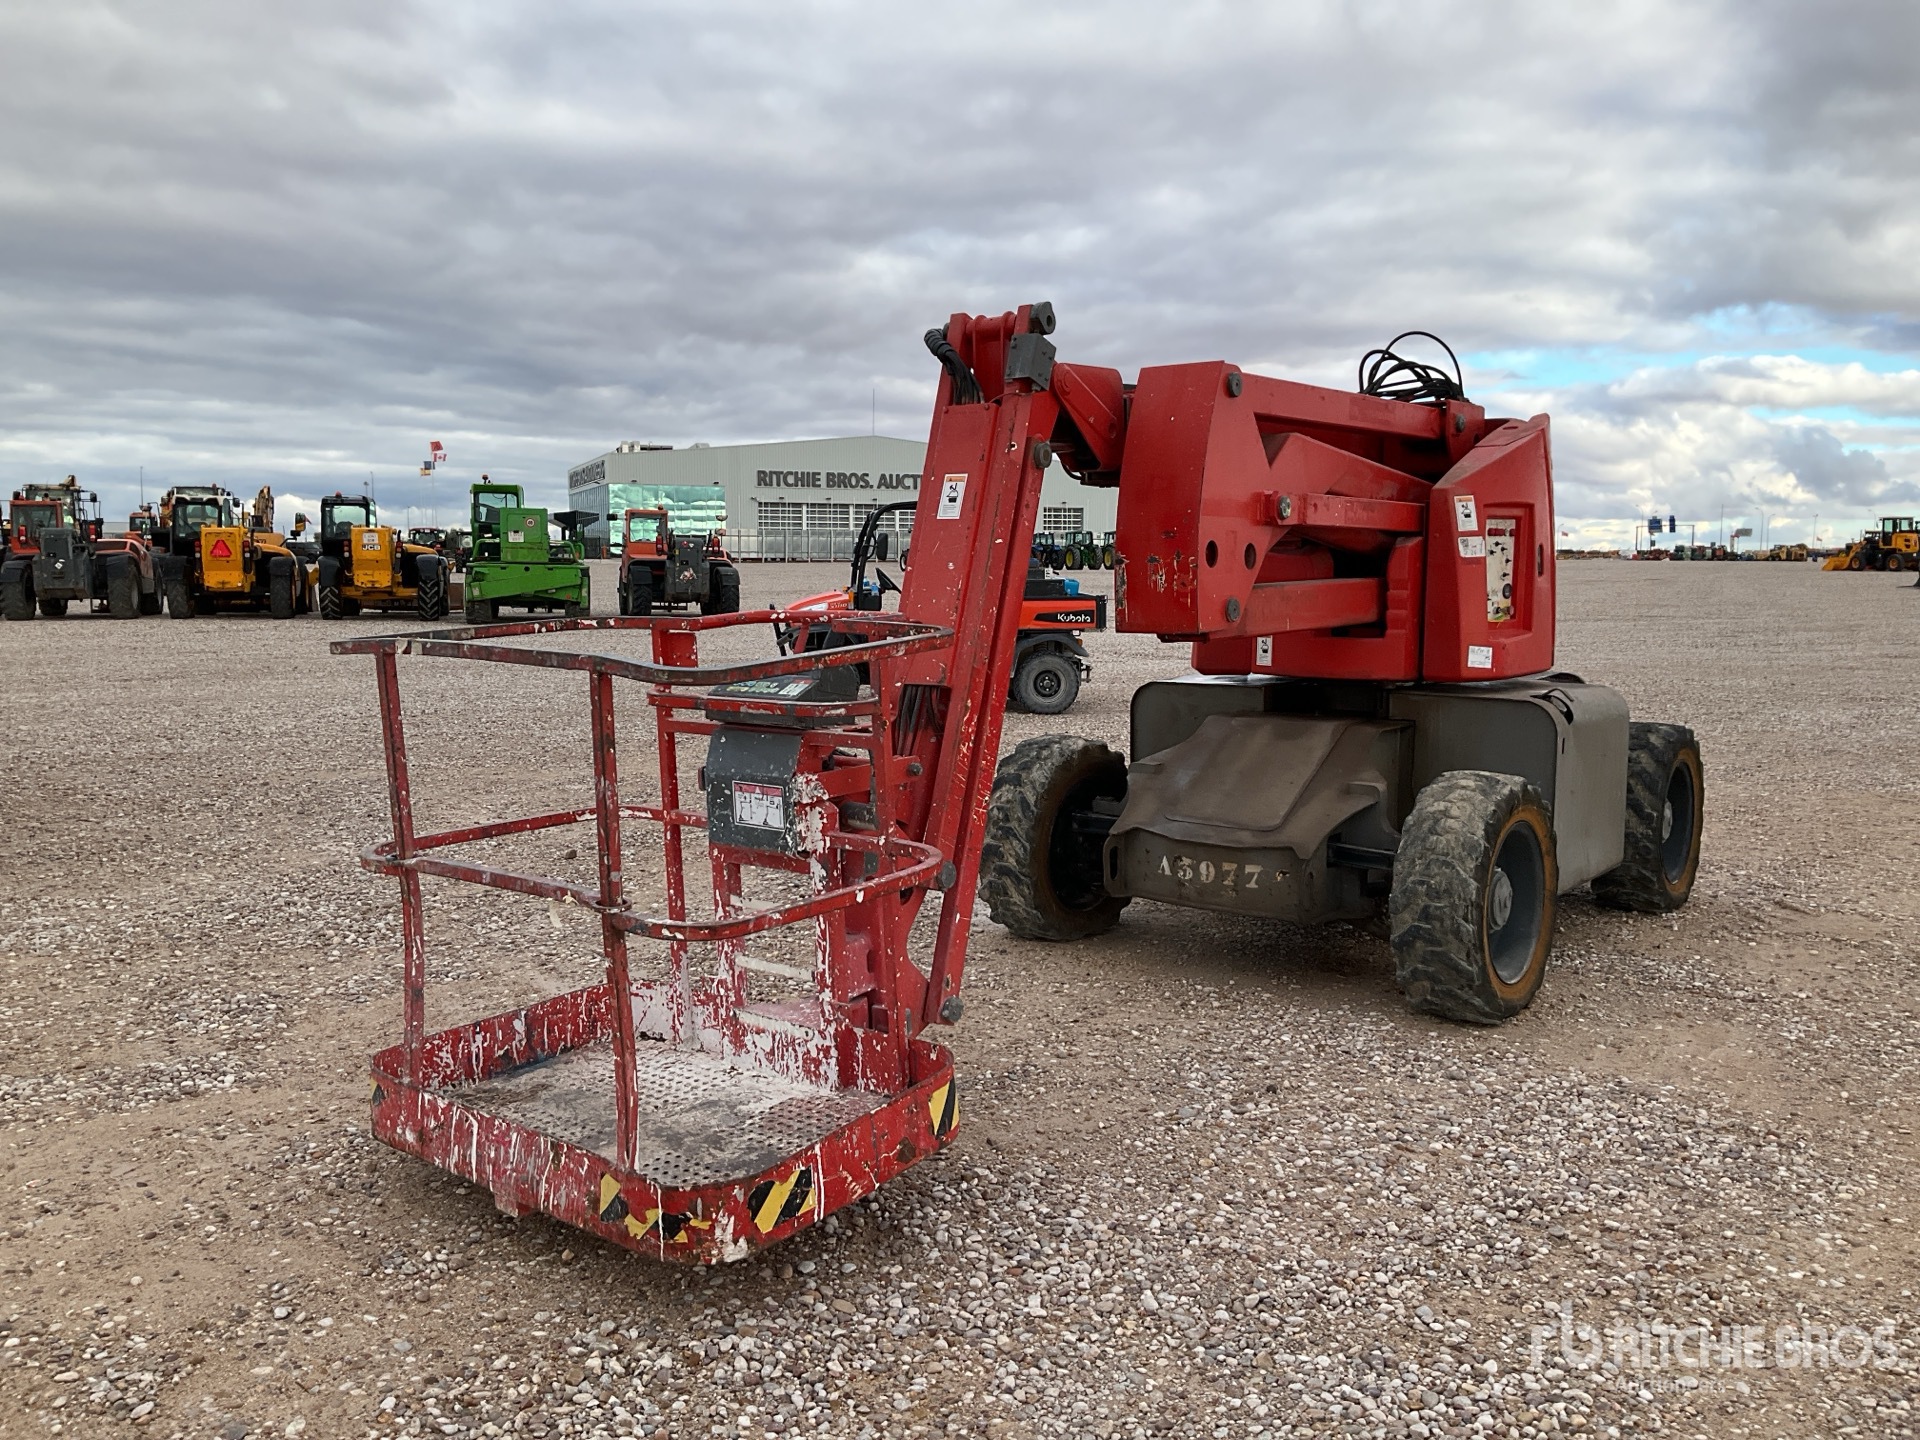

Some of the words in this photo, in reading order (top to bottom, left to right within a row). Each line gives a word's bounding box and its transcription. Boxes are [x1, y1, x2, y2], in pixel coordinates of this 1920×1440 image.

[757, 470, 821, 488] RITCHIE
[826, 472, 874, 489] BROS.
[876, 473, 922, 490] AUCT
[1057, 613, 1091, 622] Kubota
